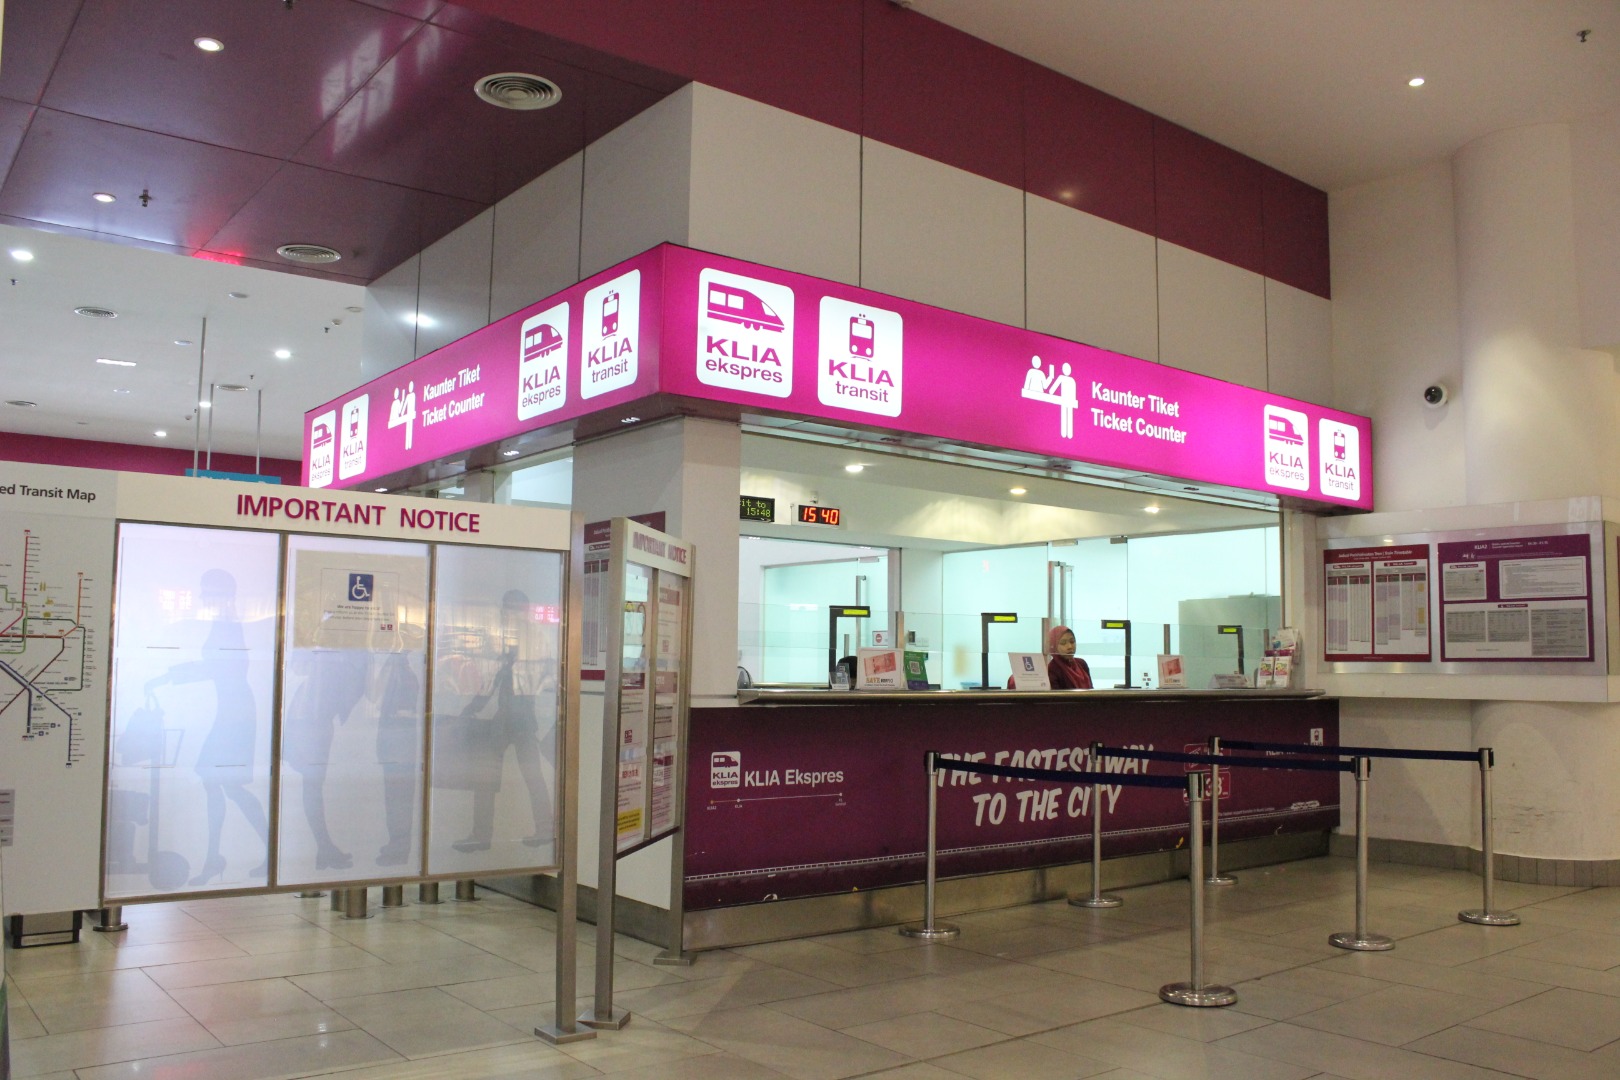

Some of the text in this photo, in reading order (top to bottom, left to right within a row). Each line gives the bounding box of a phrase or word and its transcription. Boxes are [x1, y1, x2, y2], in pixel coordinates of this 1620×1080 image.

[588, 337, 633, 368] KLIA
[706, 335, 782, 367] KLIA
[423, 363, 481, 402] Kaunter Tiket
[522, 365, 561, 393] KLIA
[592, 358, 629, 384] transit
[705, 357, 783, 383] ekspres
[828, 358, 895, 388] KLIA
[522, 384, 561, 408] ekspres
[835, 380, 889, 403] transit
[1091, 381, 1180, 418] Kaunter Tiket
[422, 392, 485, 427] Ticket Counter
[1090, 407, 1187, 444] Ticket Counter
[343, 440, 364, 458] KLIA
[1269, 451, 1304, 470] KLIA
[311, 453, 331, 471] KLIA
[1269, 466, 1305, 481] ekspres
[1324, 462, 1356, 480] KLIA
[19, 485, 63, 499] Transit
[67, 488, 96, 503] Map
[1328, 477, 1354, 491] transit
[236, 494, 480, 533] IMPORTANT NOTICE
[746, 507, 771, 518] 15:48
[756, 499, 767, 509] to
[713, 771, 738, 779] KLIA
[744, 769, 844, 788] KLIA Ekspres
[937, 751, 986, 787] THE
[972, 784, 1122, 827] TO THE CIY
